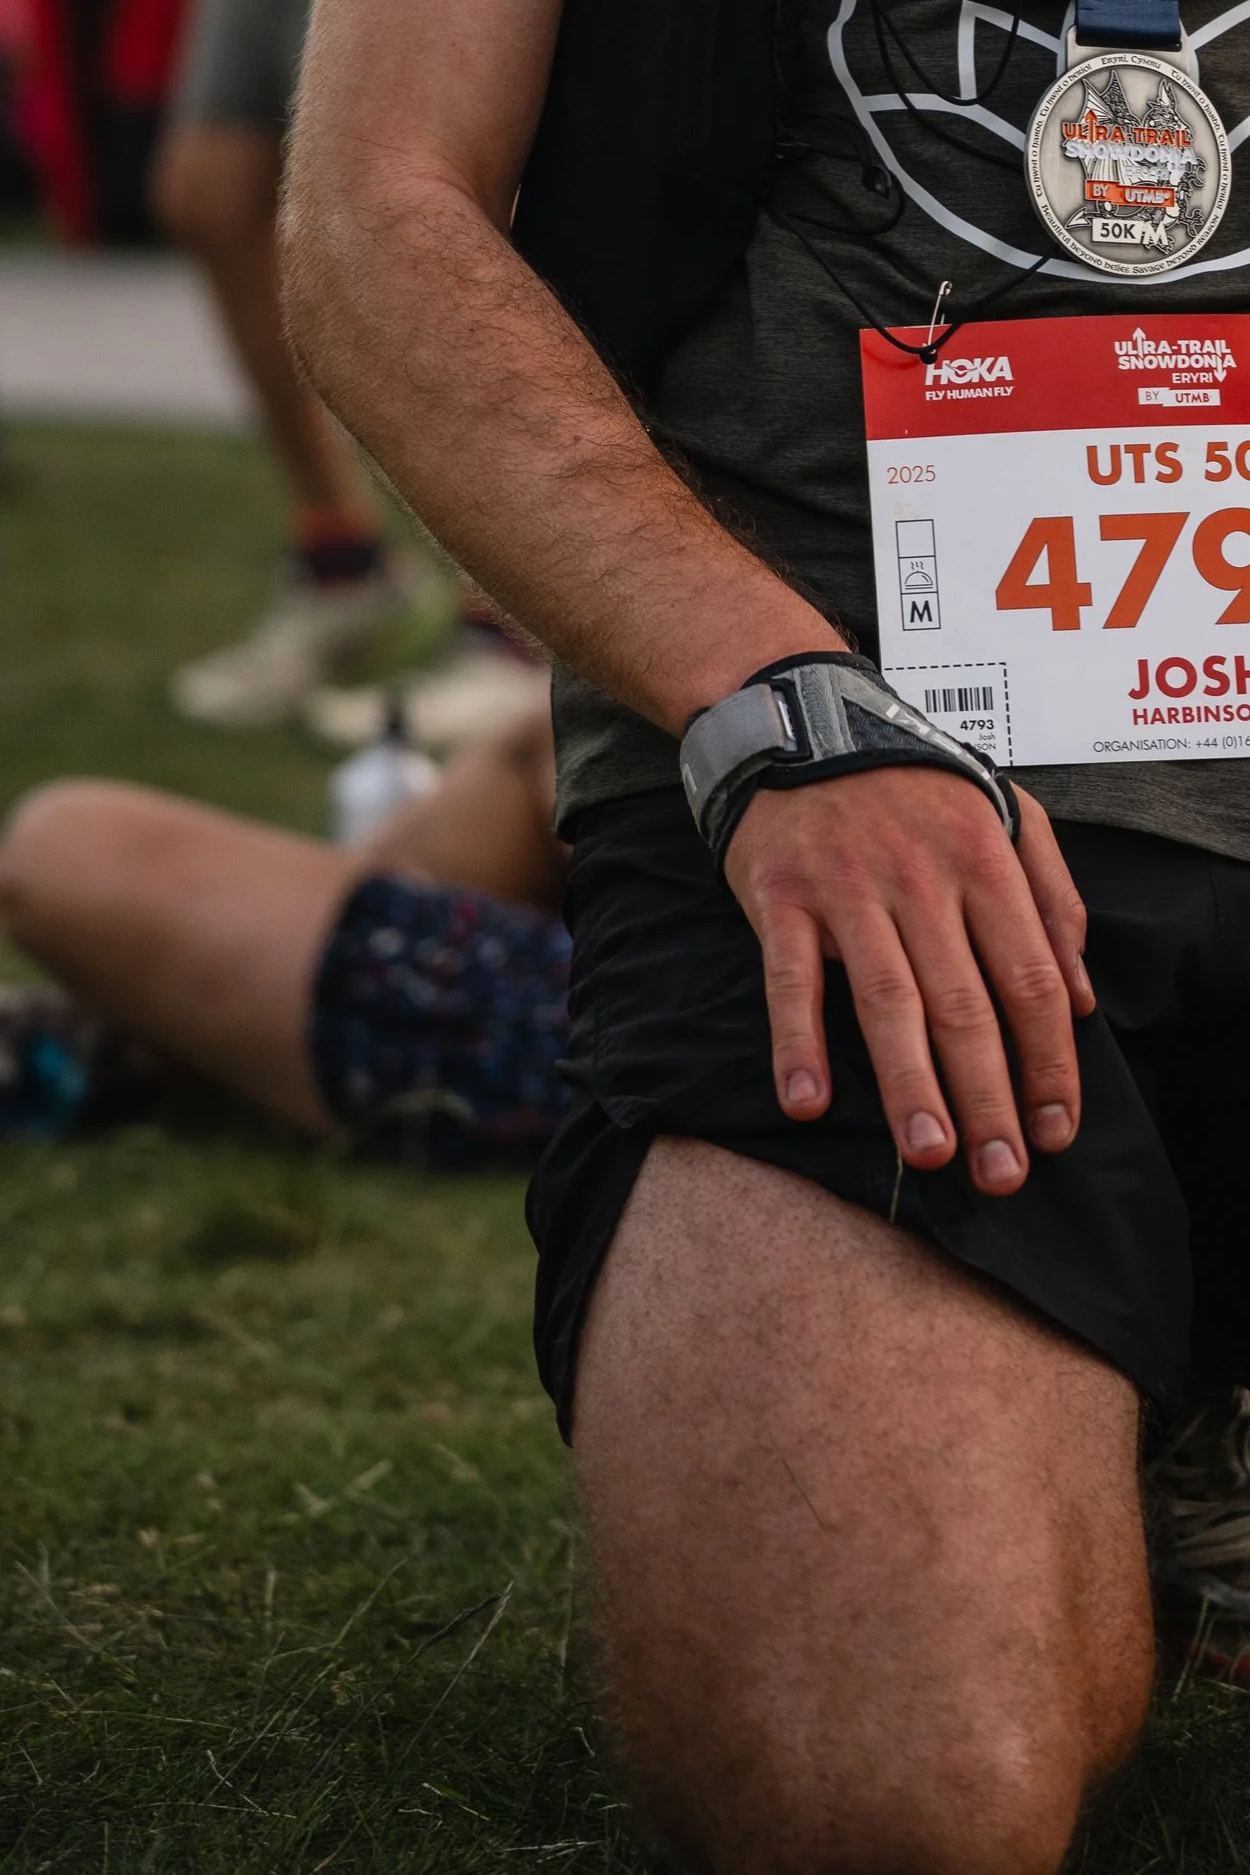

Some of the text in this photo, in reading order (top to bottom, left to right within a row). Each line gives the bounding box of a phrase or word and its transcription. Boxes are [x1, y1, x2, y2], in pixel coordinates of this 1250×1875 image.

[1092, 184, 1109, 198] BY
[1100, 222, 1136, 240] 50K
[1114, 331, 1231, 357] ULTRA-TRAIL
[925, 356, 1014, 386] HOKA
[1118, 354, 1237, 375] SNOWDONIA
[1172, 372, 1213, 384] ERYRI
[925, 386, 1014, 401] FLY HUMAN FLY
[1145, 391, 1211, 403] BY UTMB
[1086, 441, 1184, 486] UTS
[886, 464, 937, 484] 2025
[910, 600, 933, 623] M
[960, 719, 995, 731] 4793
[978, 733, 996, 742] Josh
[1093, 737, 1191, 753] ORGANISATION:
[1195, 737, 1218, 749] +44
